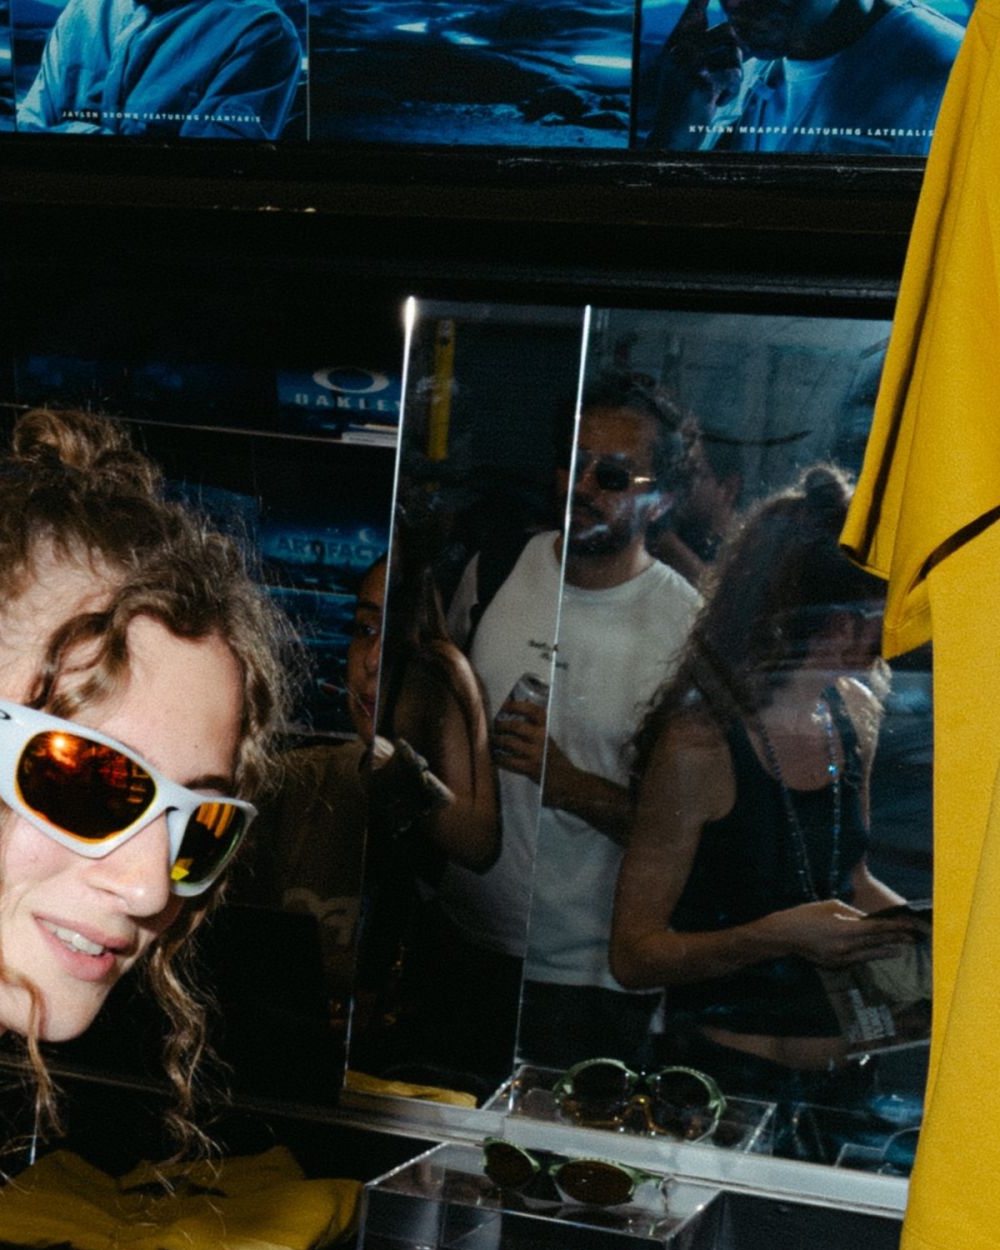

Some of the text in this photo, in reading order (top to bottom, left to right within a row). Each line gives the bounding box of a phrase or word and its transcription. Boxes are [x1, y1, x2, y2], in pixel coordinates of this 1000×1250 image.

[143, 113, 200, 121] FEATURING
[204, 115, 261, 123] PLANTARIS
[688, 125, 733, 133] KYLIAN
[793, 127, 862, 136] FEATURING
